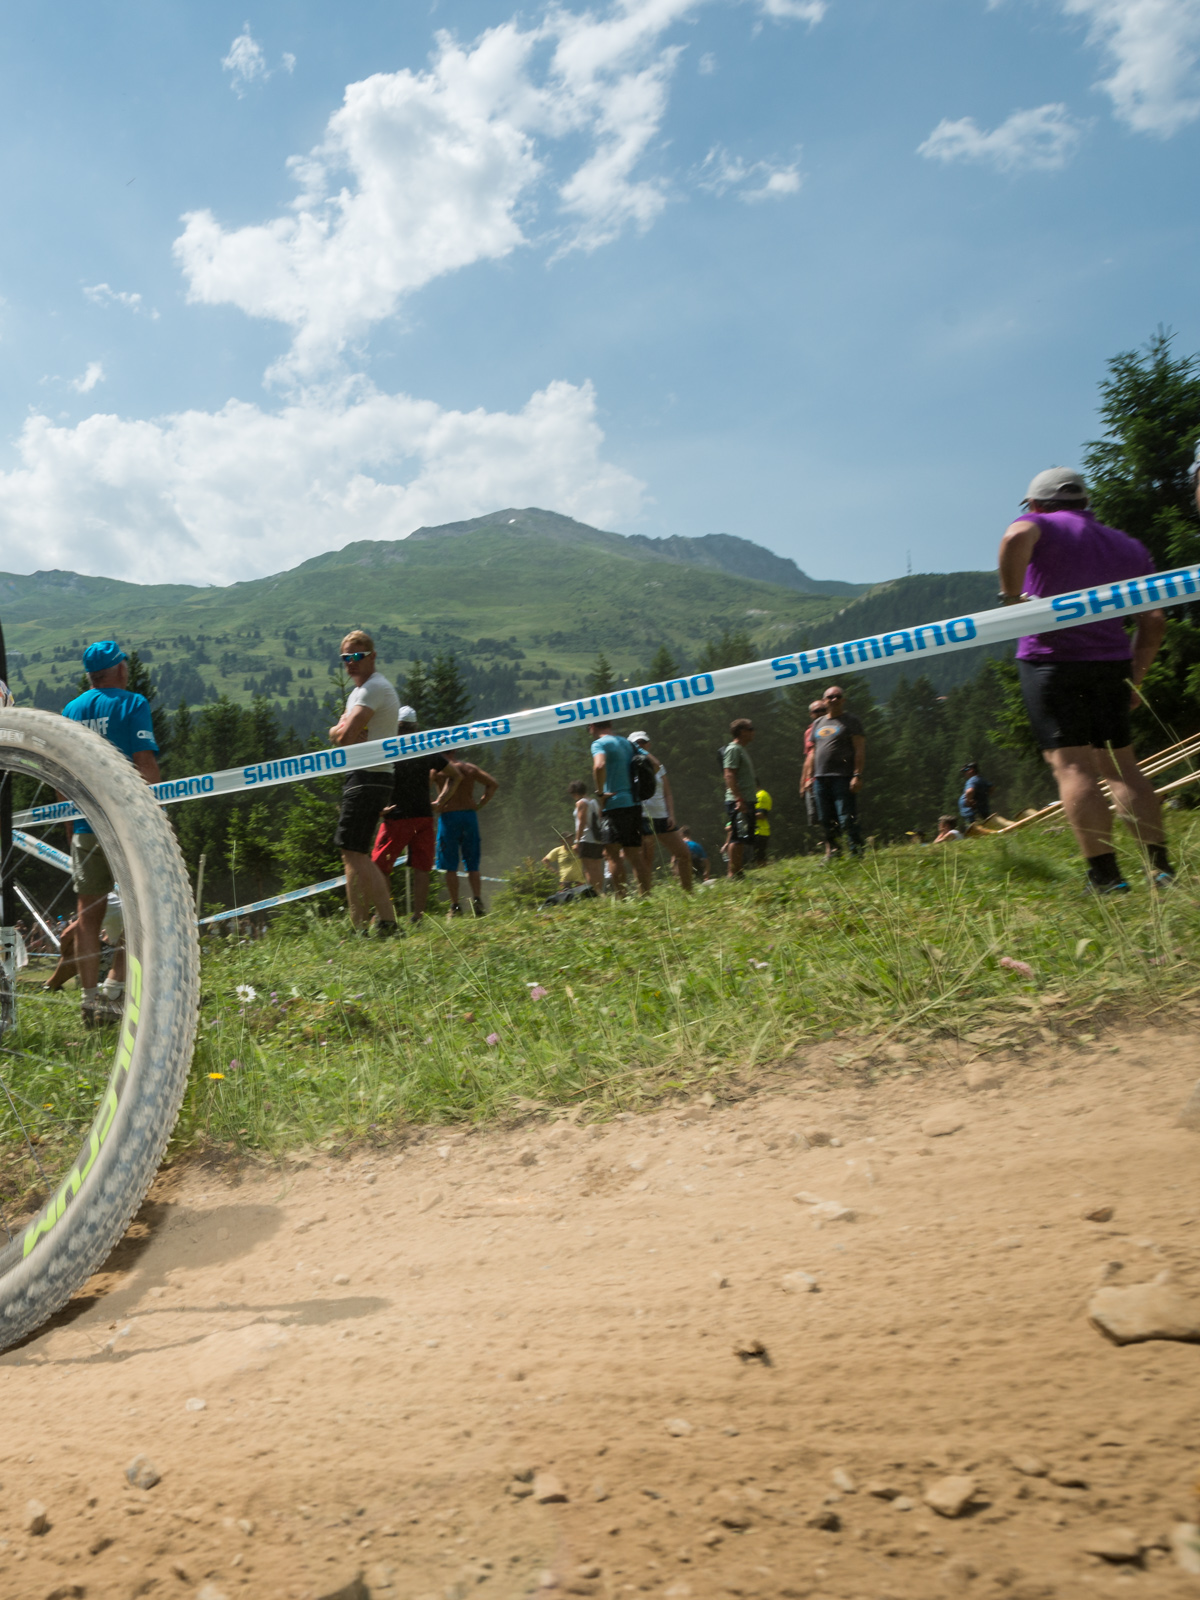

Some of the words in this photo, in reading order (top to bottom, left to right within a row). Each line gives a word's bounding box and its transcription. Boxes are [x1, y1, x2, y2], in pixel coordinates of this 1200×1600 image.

[1052, 569, 1200, 622] SHIM
[771, 617, 978, 682] SHIMANO
[555, 673, 715, 726] SHIMANO
[81, 716, 109, 735] TAFF
[382, 719, 511, 760] SHIMANO
[244, 749, 347, 785] SHIMANO
